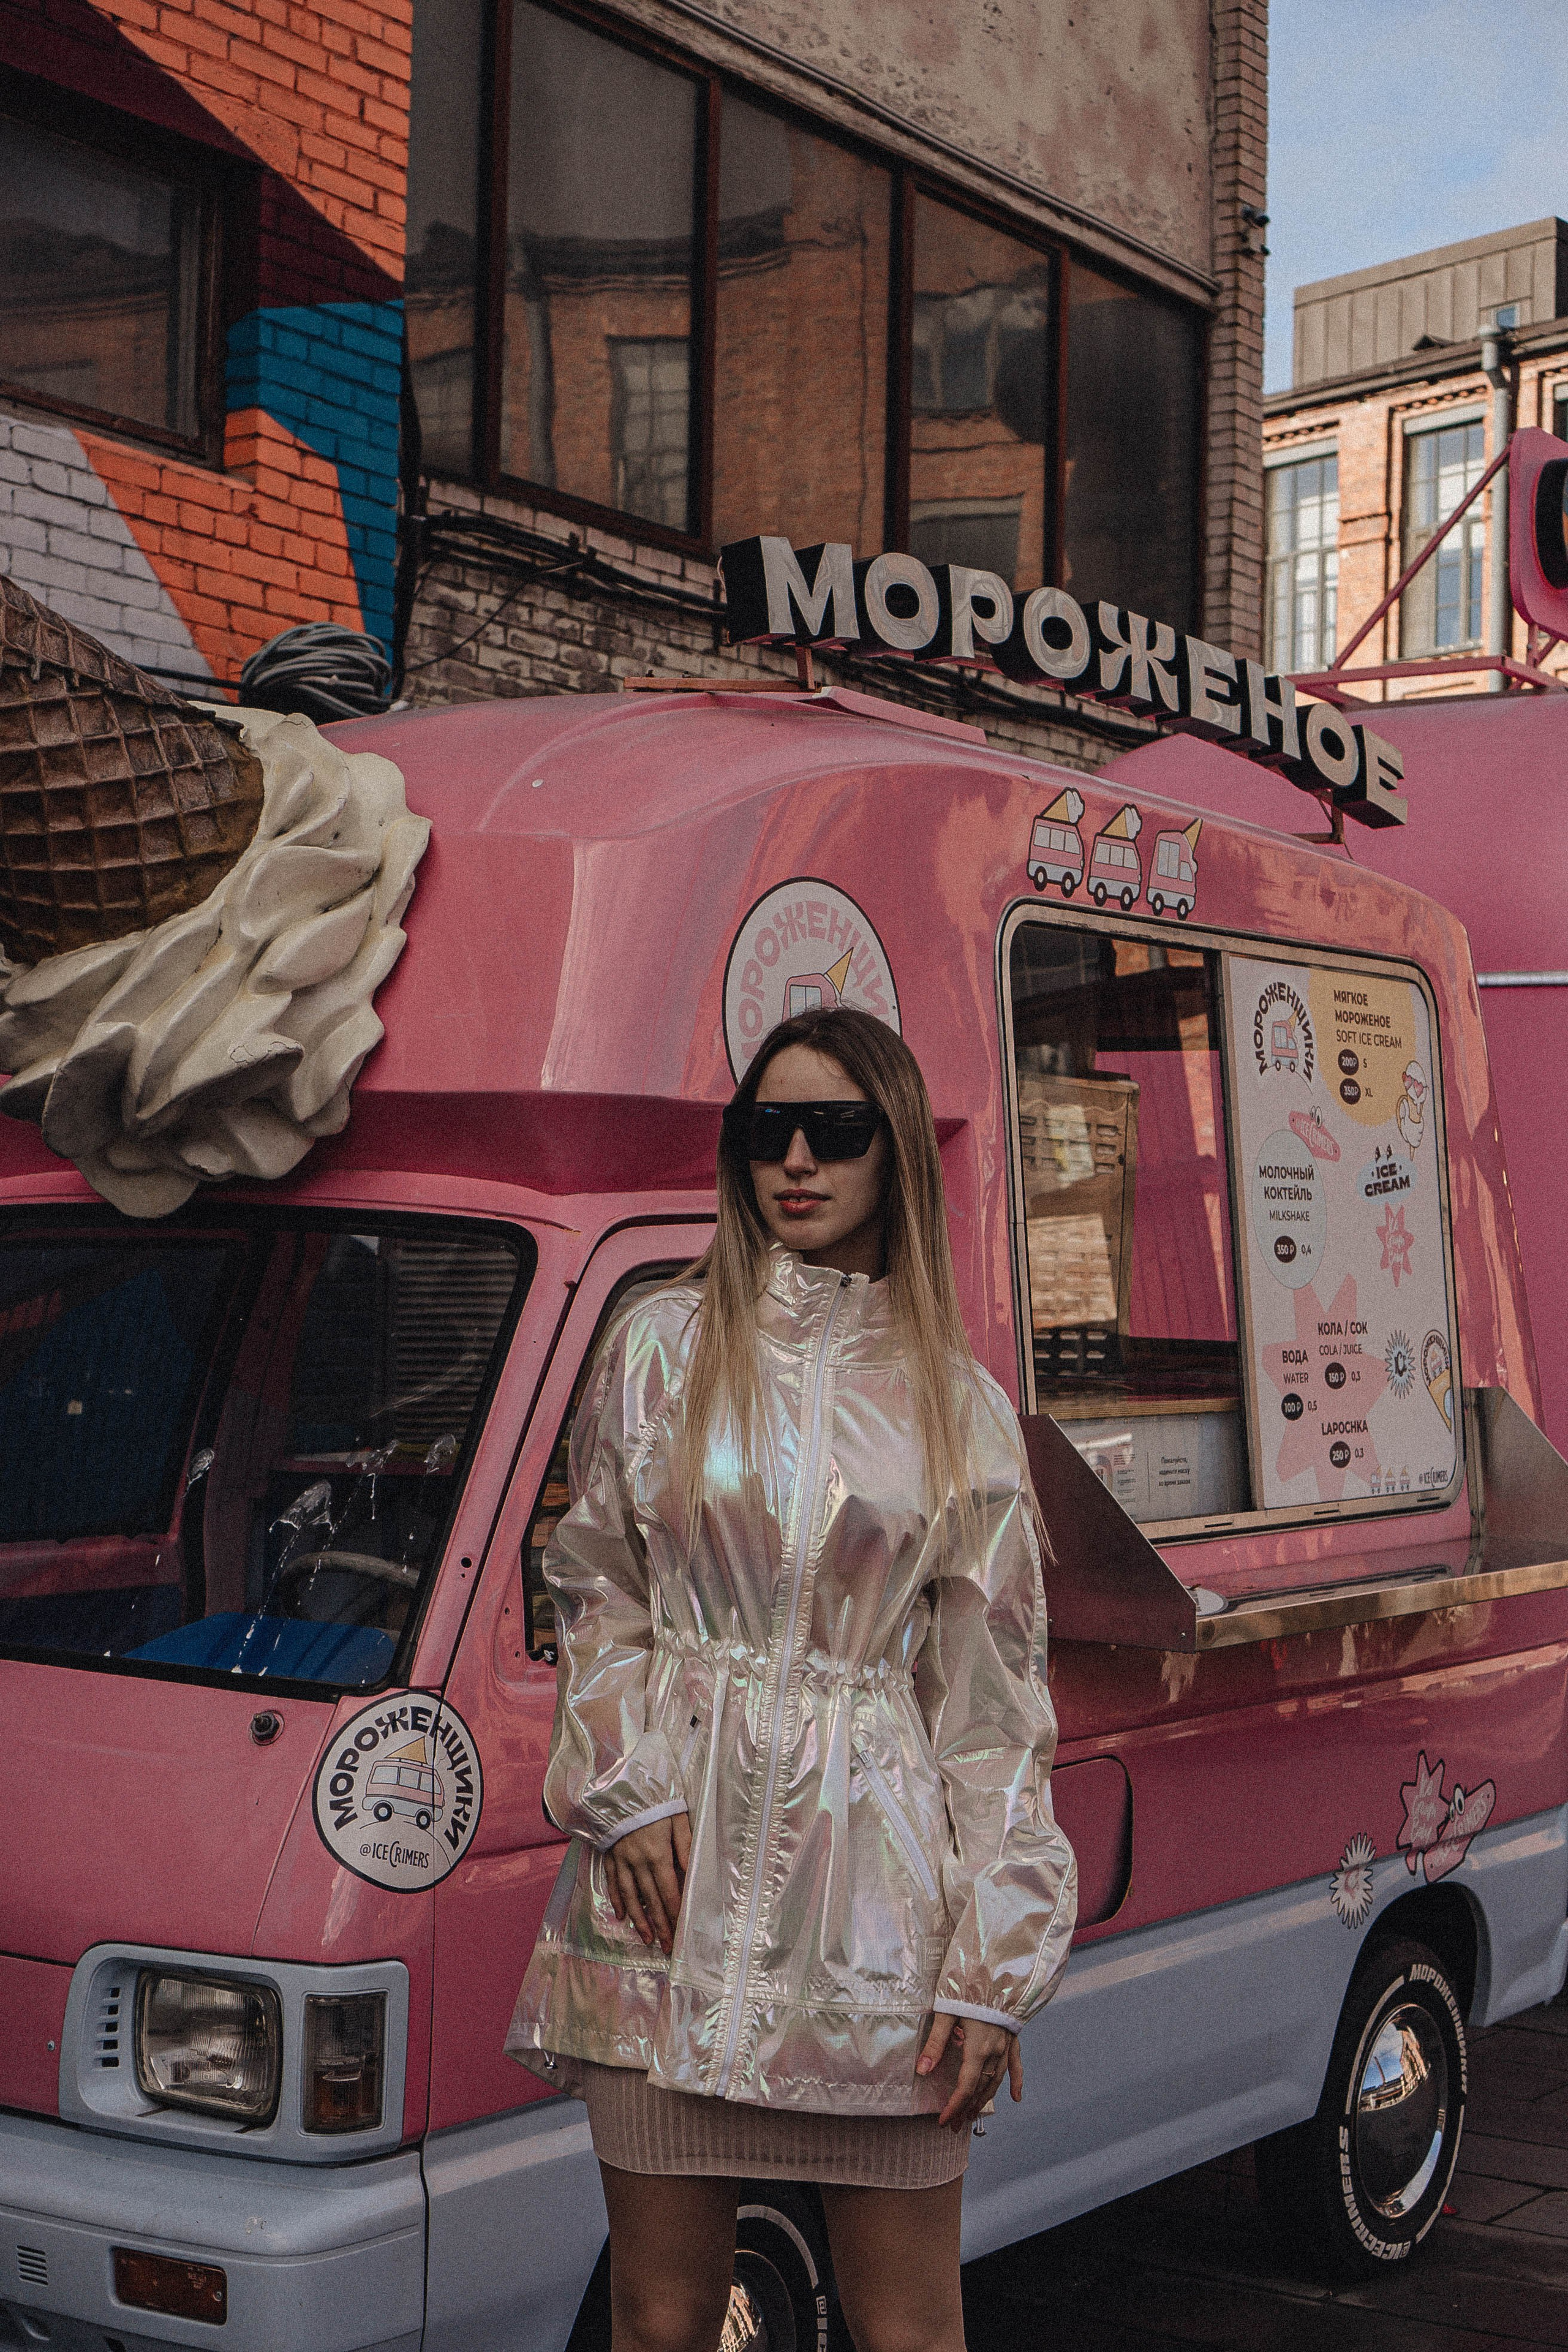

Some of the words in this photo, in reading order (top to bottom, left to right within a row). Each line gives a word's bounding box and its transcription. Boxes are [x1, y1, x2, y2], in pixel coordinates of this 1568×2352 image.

[758, 534, 1408, 827] МОРОЖЕНОЕ
[1333, 989, 1368, 1006] МЯГКОЕ
[1335, 1009, 1391, 1028] МОРОЖЕНОЕ
[1253, 981, 1314, 1083] МОРОЖЕНЩИКИ
[1336, 1029, 1357, 1042] SOFT
[1359, 1032, 1373, 1046] ICE
[1373, 1034, 1402, 1049] CREAM
[1363, 1058, 1367, 1068] S
[1365, 1087, 1373, 1098] XL
[1259, 1164, 1314, 1180] МОЛОЧНЫЙ
[1376, 1163, 1397, 1179] ICE
[1264, 1184, 1313, 1201] КОКТЕЙЛЬ
[1364, 1175, 1410, 1197] CREAM
[1269, 1210, 1310, 1221] MILKSHAKE
[1317, 1322, 1343, 1335] КОЛА
[1350, 1321, 1368, 1335] СОК
[1282, 1349, 1309, 1365] ВОДА
[1319, 1344, 1338, 1355] COLA
[1343, 1344, 1363, 1355] JUICE
[1283, 1372, 1309, 1384] WATER
[1284, 1403, 1296, 1413] 100
[1321, 1419, 1369, 1436] LAPOCHKA
[328, 1706, 474, 1852] МОРОЖЕНЩИКИ
